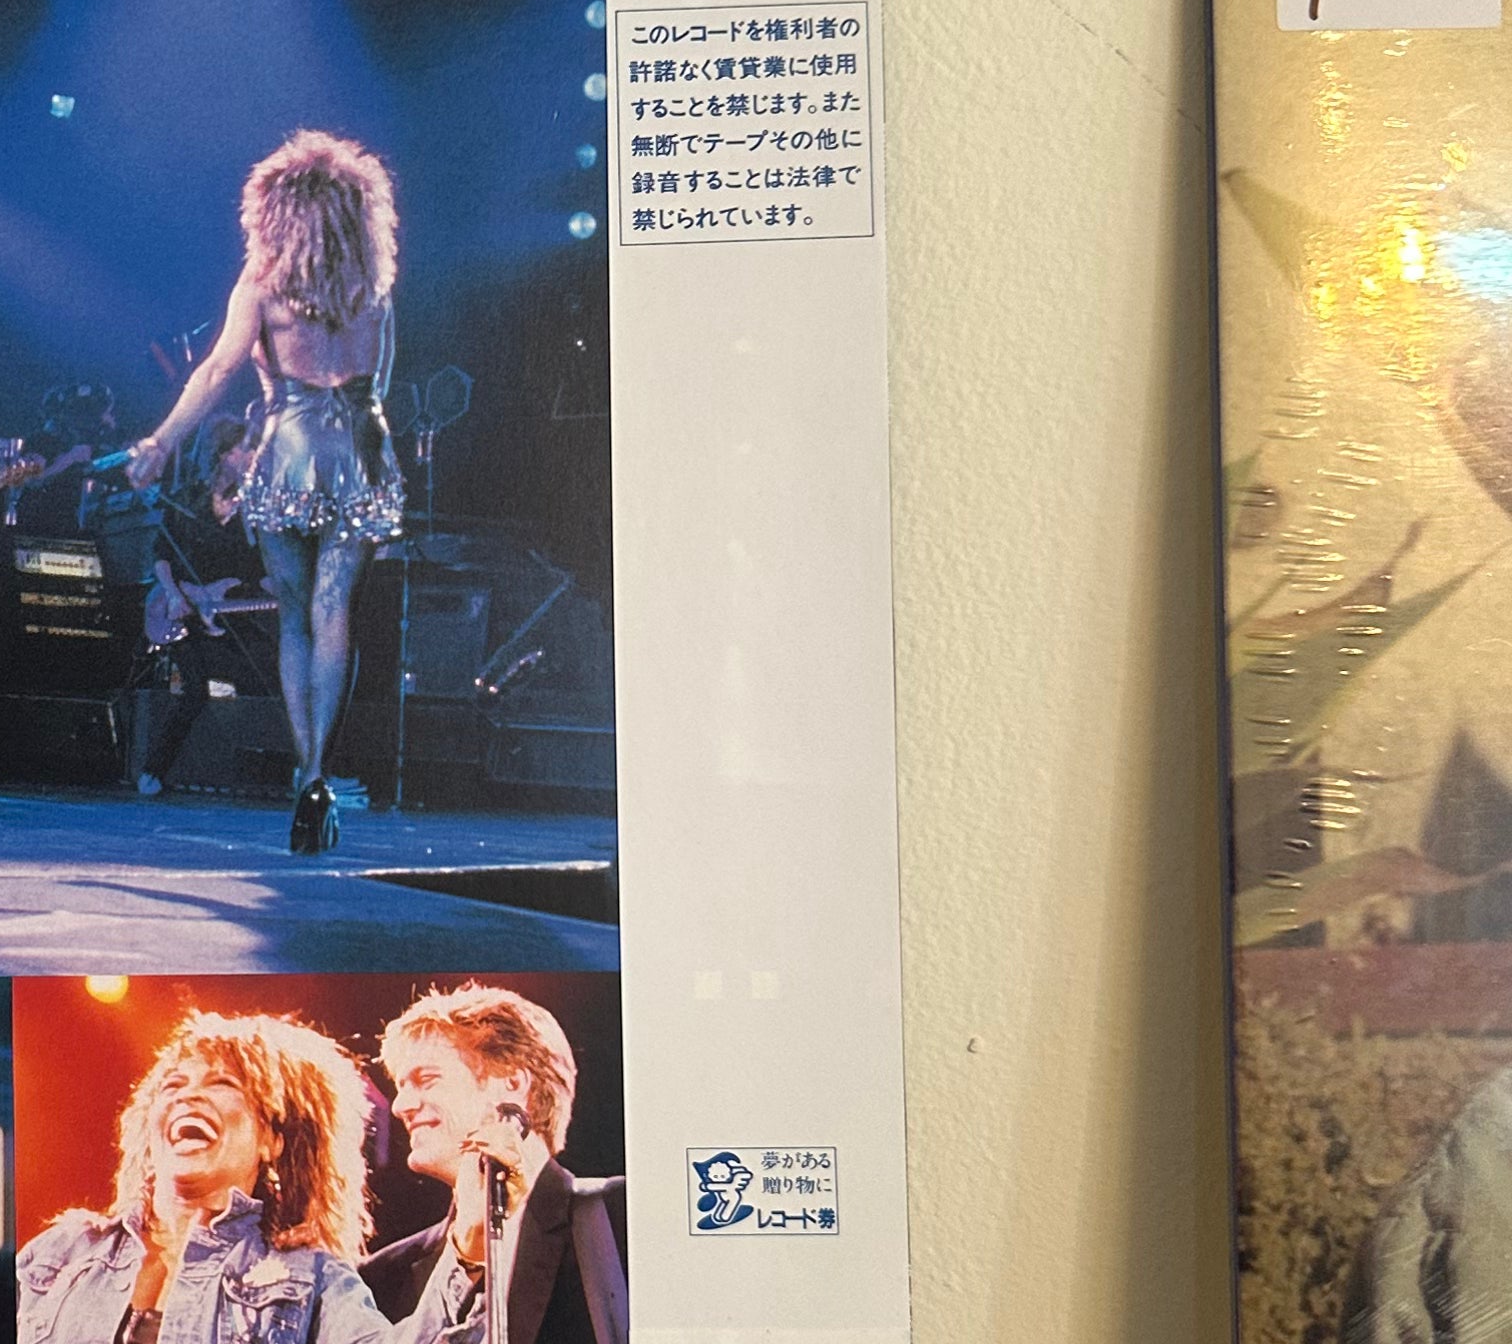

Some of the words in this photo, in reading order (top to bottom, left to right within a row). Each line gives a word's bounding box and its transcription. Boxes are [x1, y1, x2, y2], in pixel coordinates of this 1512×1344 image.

[631, 17, 860, 44] このレコードを権利者の
[629, 54, 857, 83] 許諾なく賃貸業に使用
[631, 91, 861, 120] することを禁じます。また
[631, 128, 862, 157] 無断でテープその他に
[631, 165, 861, 194] 録音することは法律で
[632, 204, 813, 231] 禁じられています。
[761, 1151, 831, 1169] 夢がある
[762, 1175, 832, 1194] 贈り物に
[757, 1207, 836, 1229] レコード券
